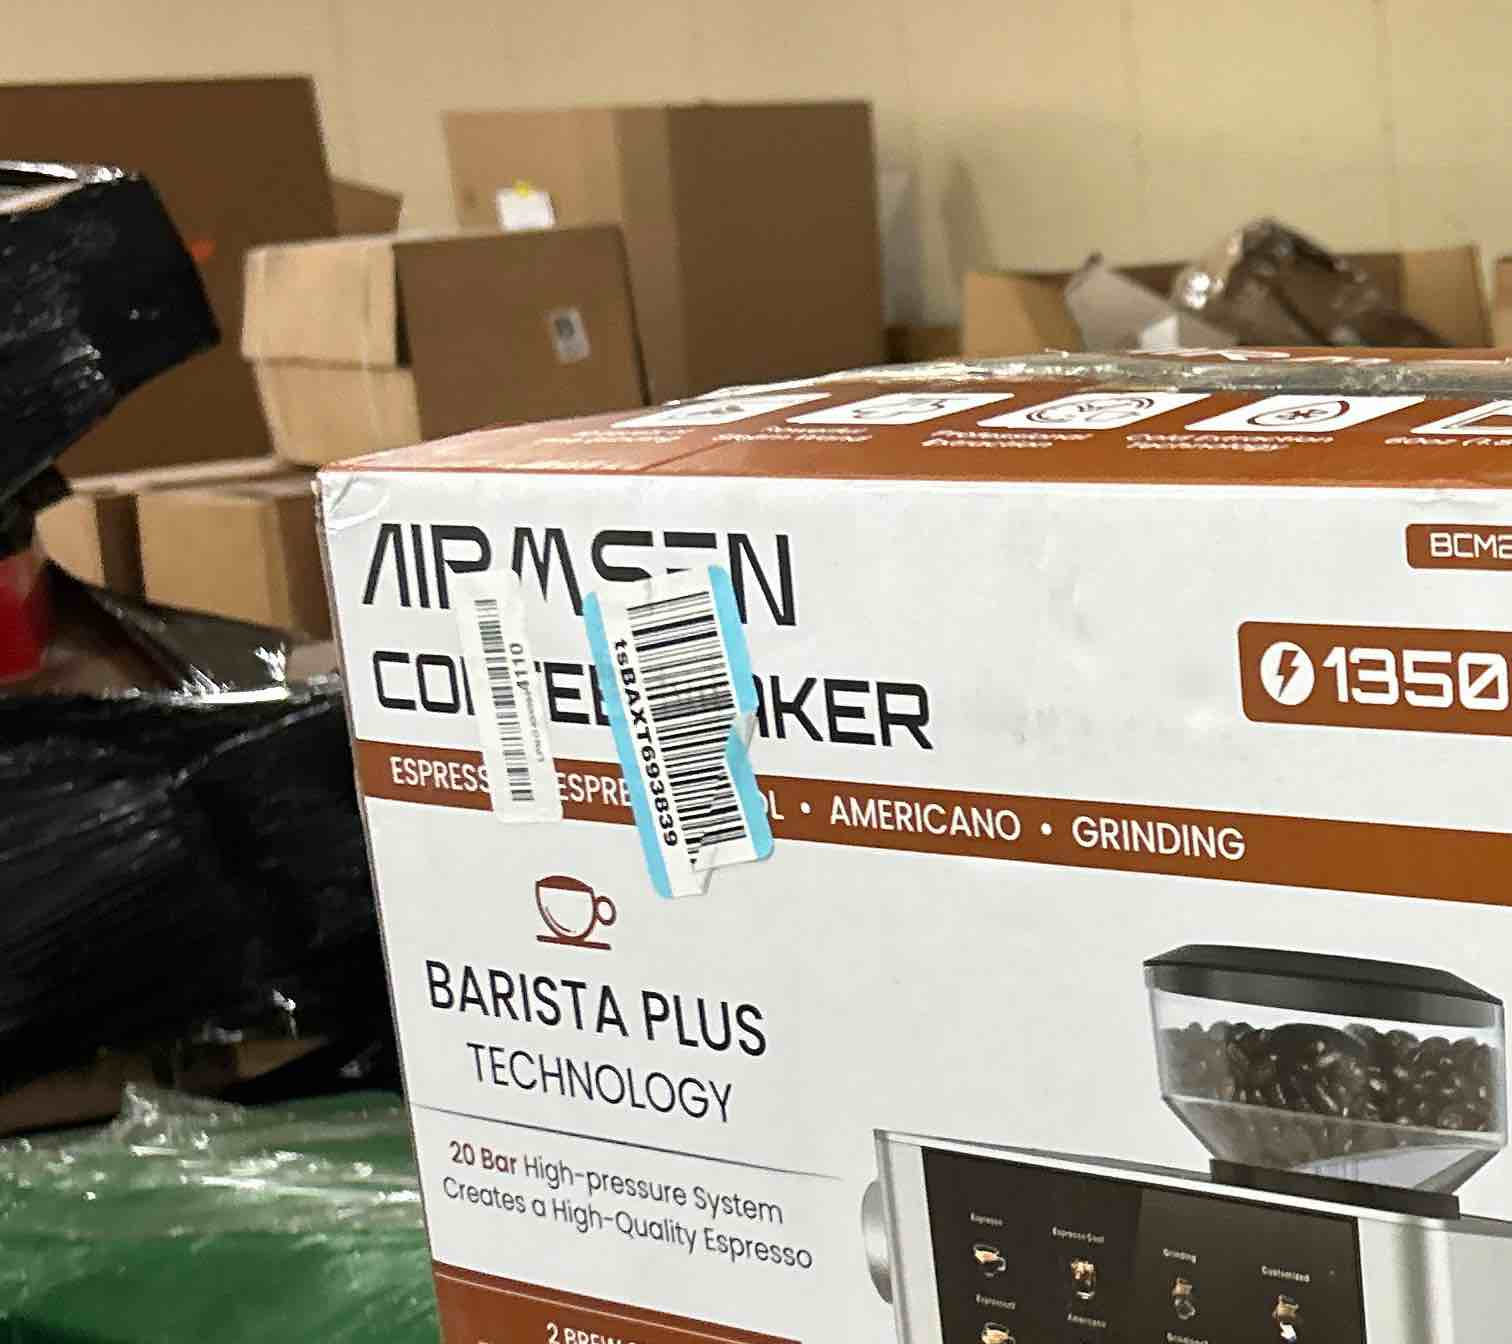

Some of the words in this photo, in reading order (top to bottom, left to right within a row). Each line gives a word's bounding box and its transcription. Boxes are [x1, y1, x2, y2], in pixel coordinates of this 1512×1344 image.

[615, 639, 678, 847] tsBAXT693839
[829, 794, 1022, 842] AMERICANO
[1073, 815, 1246, 861] GRINDING
[425, 959, 629, 1038] BARISTA
[641, 989, 767, 1056] PLUS
[466, 1041, 732, 1122] TECHNOLOGY
[443, 1177, 526, 1215] Creates
[531, 1199, 547, 1217] a
[552, 1197, 697, 1254] High-Quality
[704, 1227, 813, 1270] Espresso
[449, 1141, 475, 1167] 20
[481, 1147, 517, 1176] Bar
[524, 1154, 688, 1206] High-pressure
[694, 1186, 783, 1225] System
